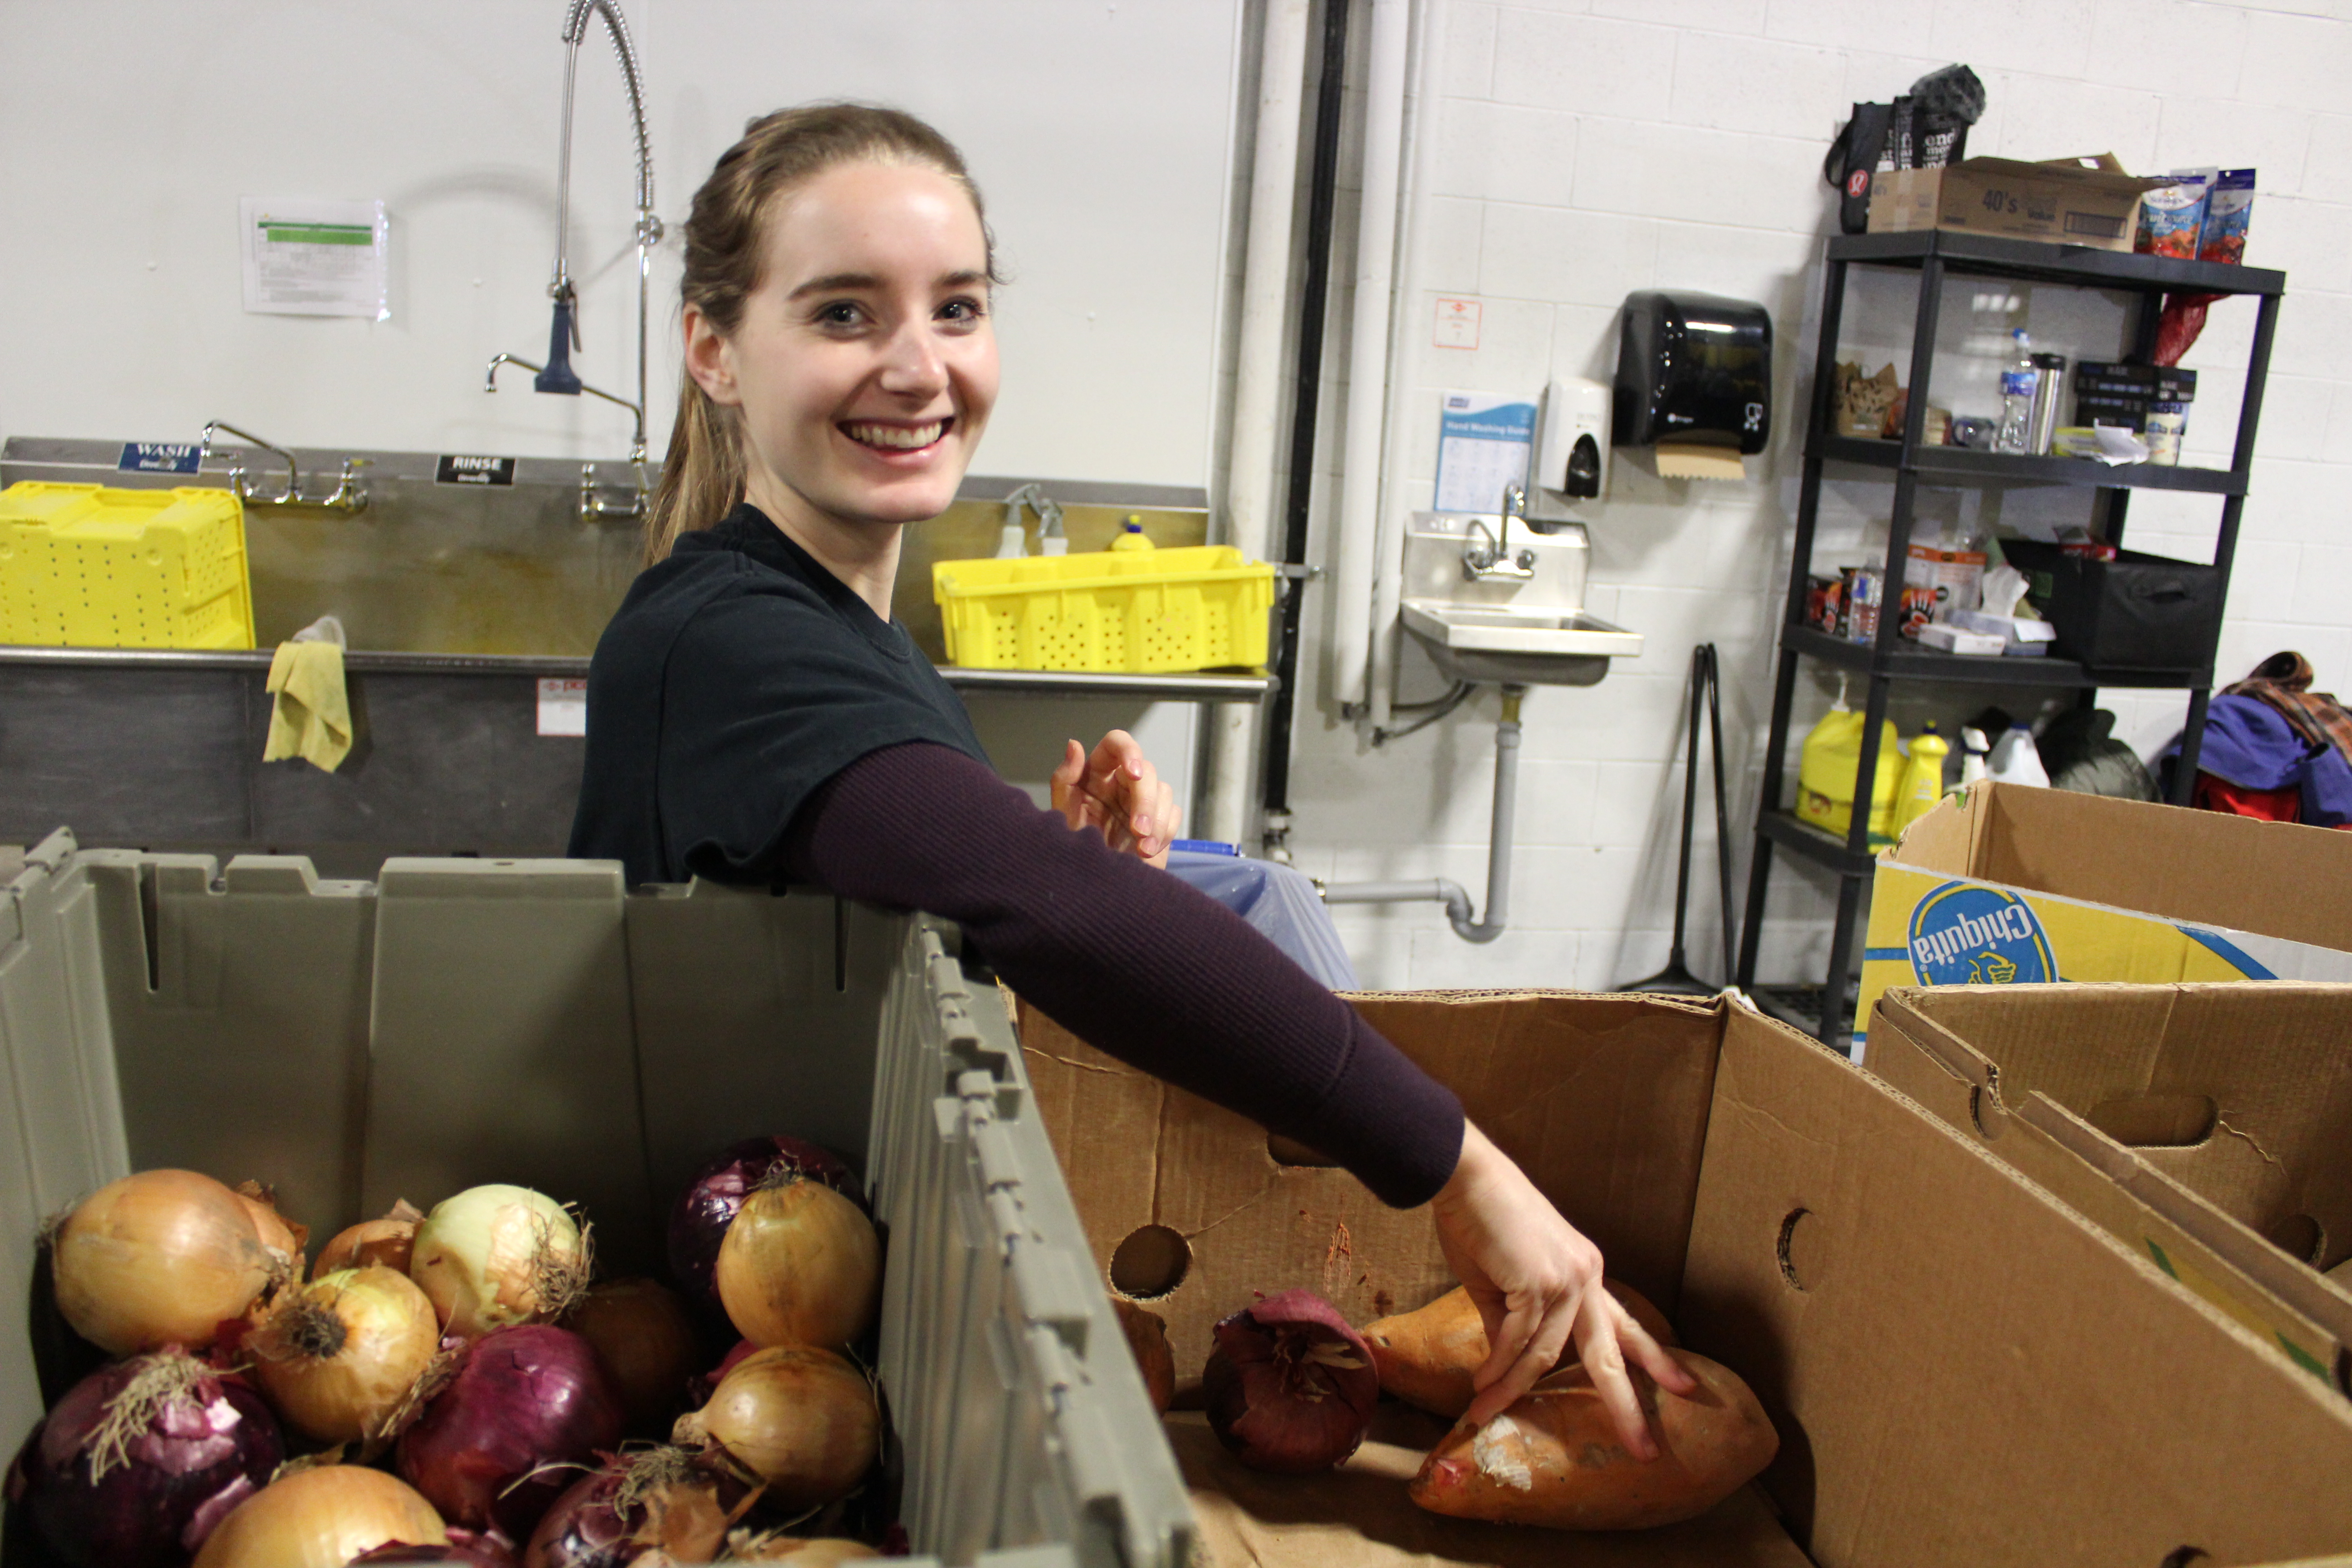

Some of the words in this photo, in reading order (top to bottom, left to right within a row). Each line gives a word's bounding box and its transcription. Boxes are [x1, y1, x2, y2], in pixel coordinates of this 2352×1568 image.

[1983, 189, 2018, 214] 40's
[1446, 421, 1470, 430] Hand
[1471, 422, 1506, 435] Washing
[137, 443, 191, 458] WASH
[453, 456, 502, 470] RINSE
[1913, 904, 2034, 966] Chiquita
